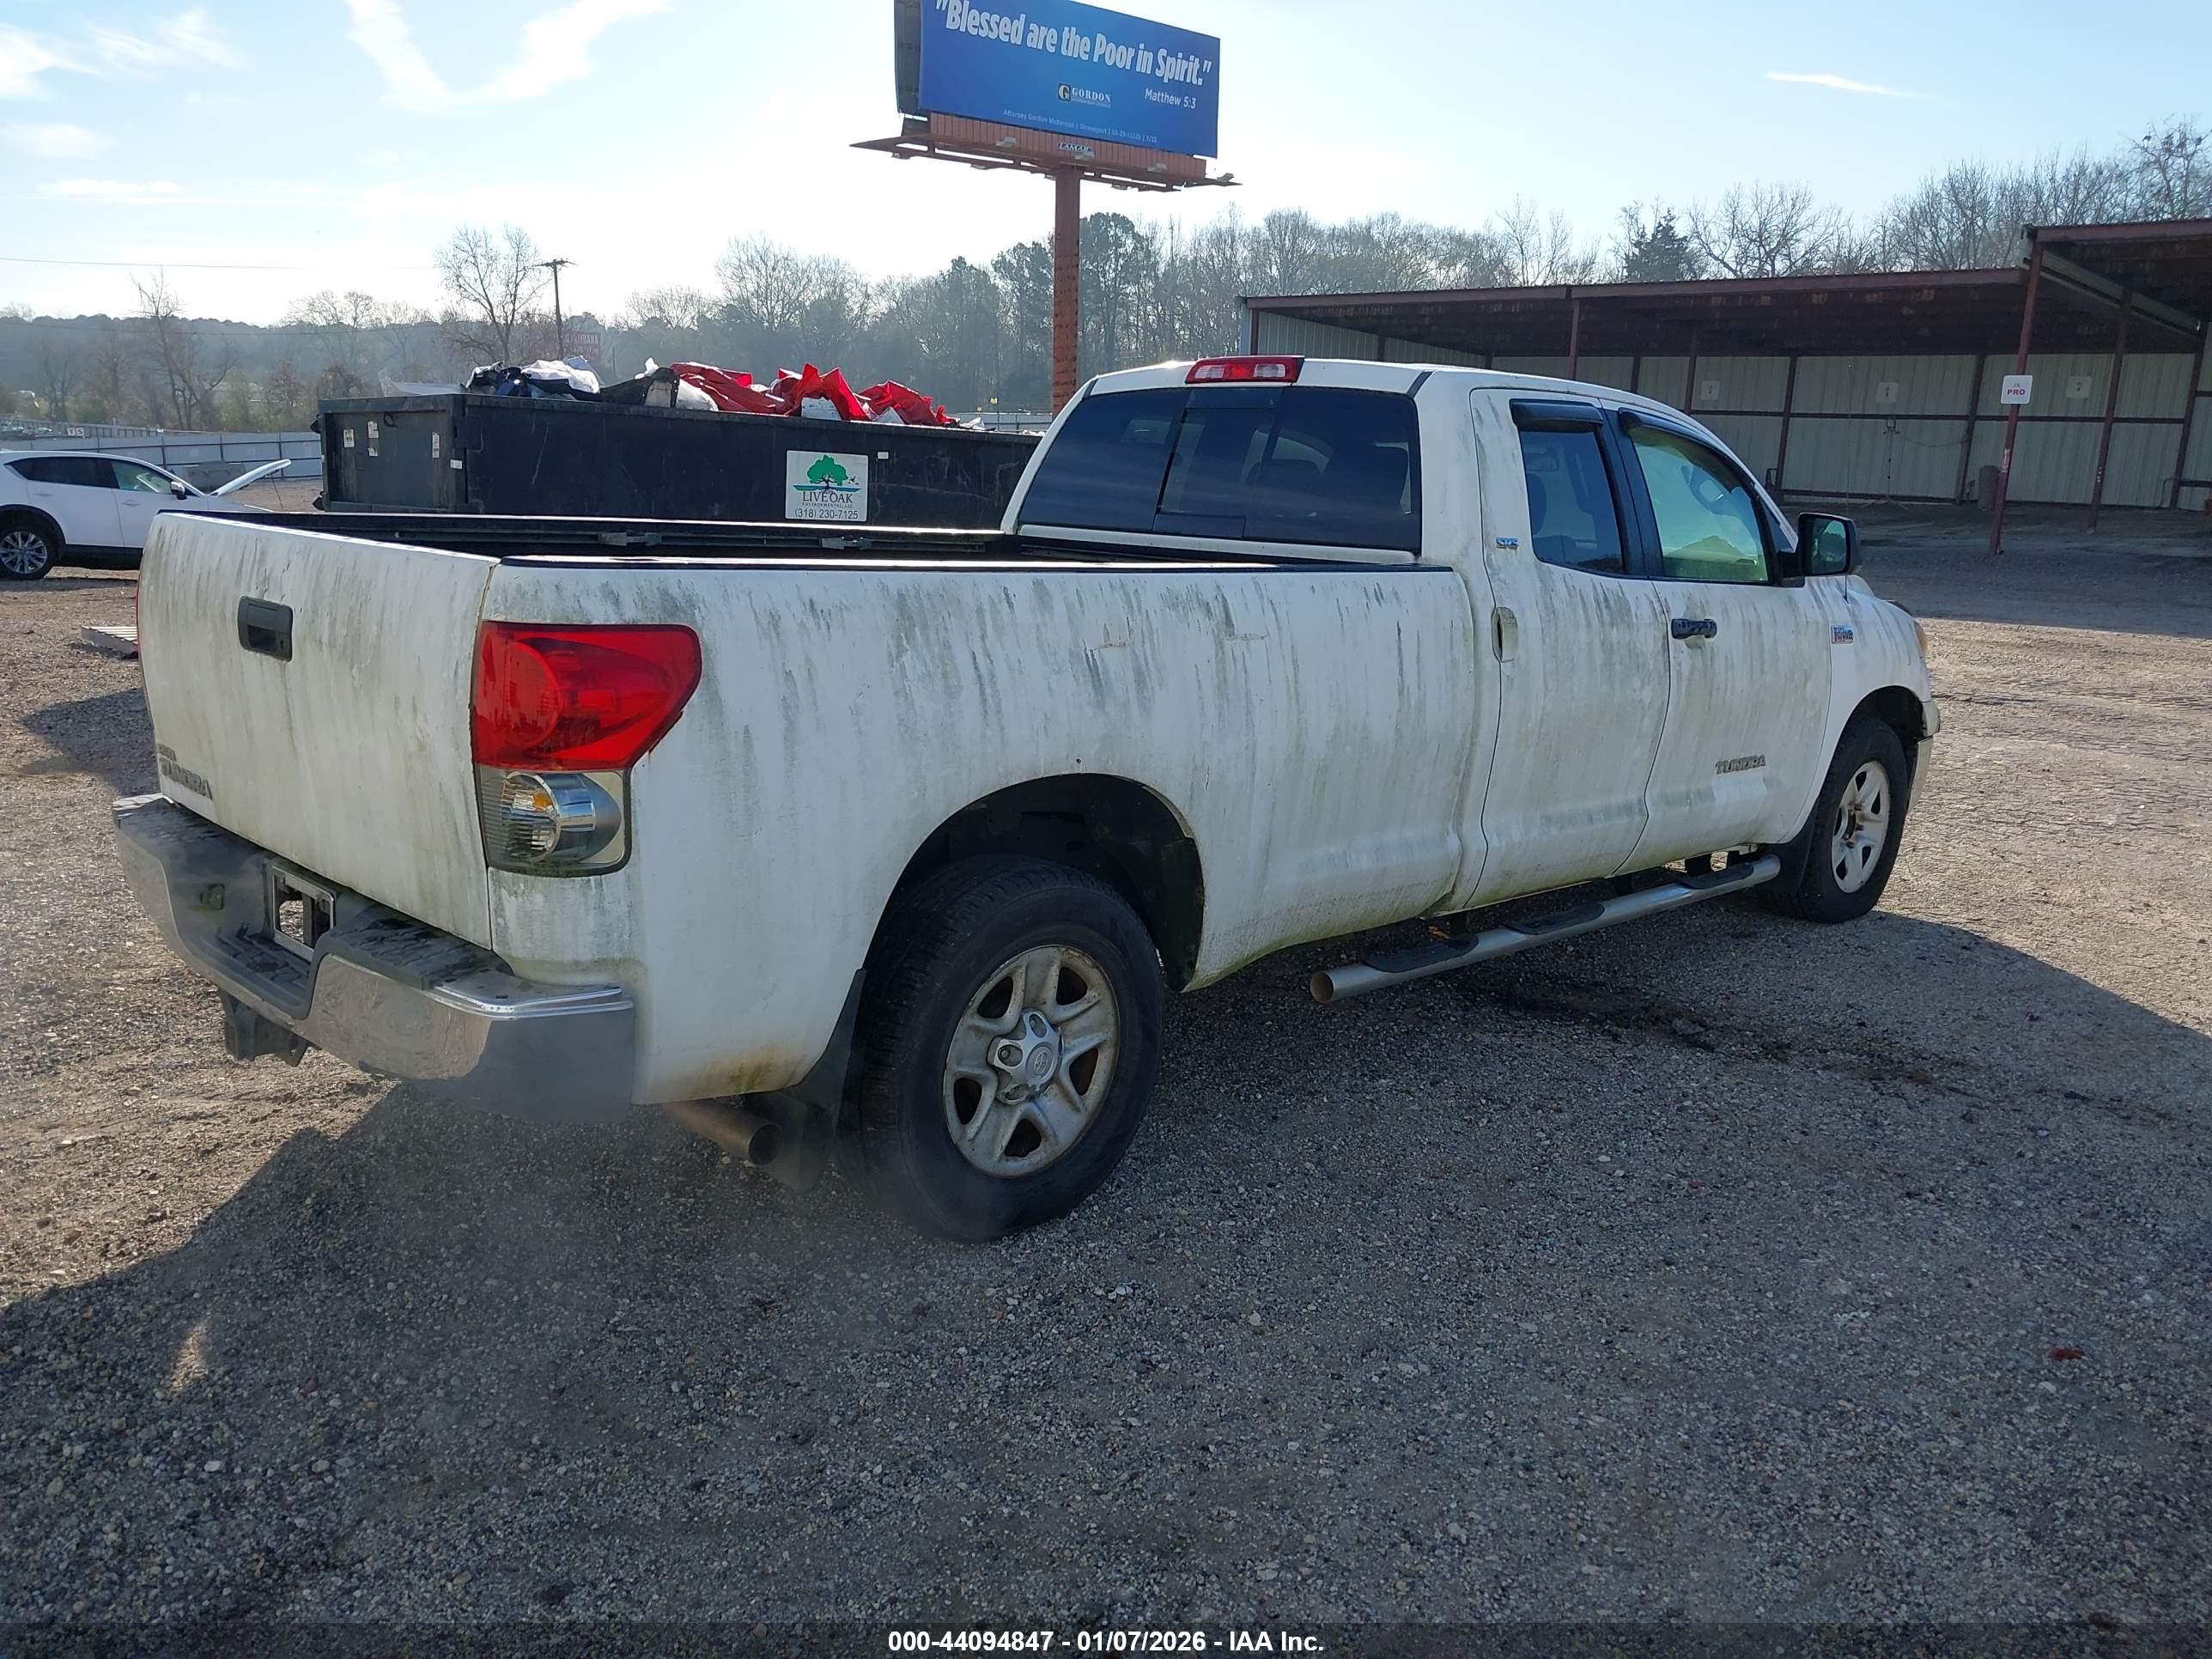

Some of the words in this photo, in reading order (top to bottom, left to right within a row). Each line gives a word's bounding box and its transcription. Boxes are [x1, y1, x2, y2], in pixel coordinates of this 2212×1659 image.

[1027, 23, 1057, 53] are
[1061, 27, 1090, 61] the
[1093, 33, 1135, 71] Poor
[1136, 43, 1154, 75] in
[1156, 48, 1212, 86] Spirit."
[1072, 86, 1112, 104] GORDON
[1145, 88, 1182, 106] Matthew
[1183, 97, 1197, 109] 5:3
[803, 491, 828, 502] LIVE
[830, 493, 853, 503] OAK
[795, 508, 817, 519] (318)
[819, 508, 859, 520] 230-7125
